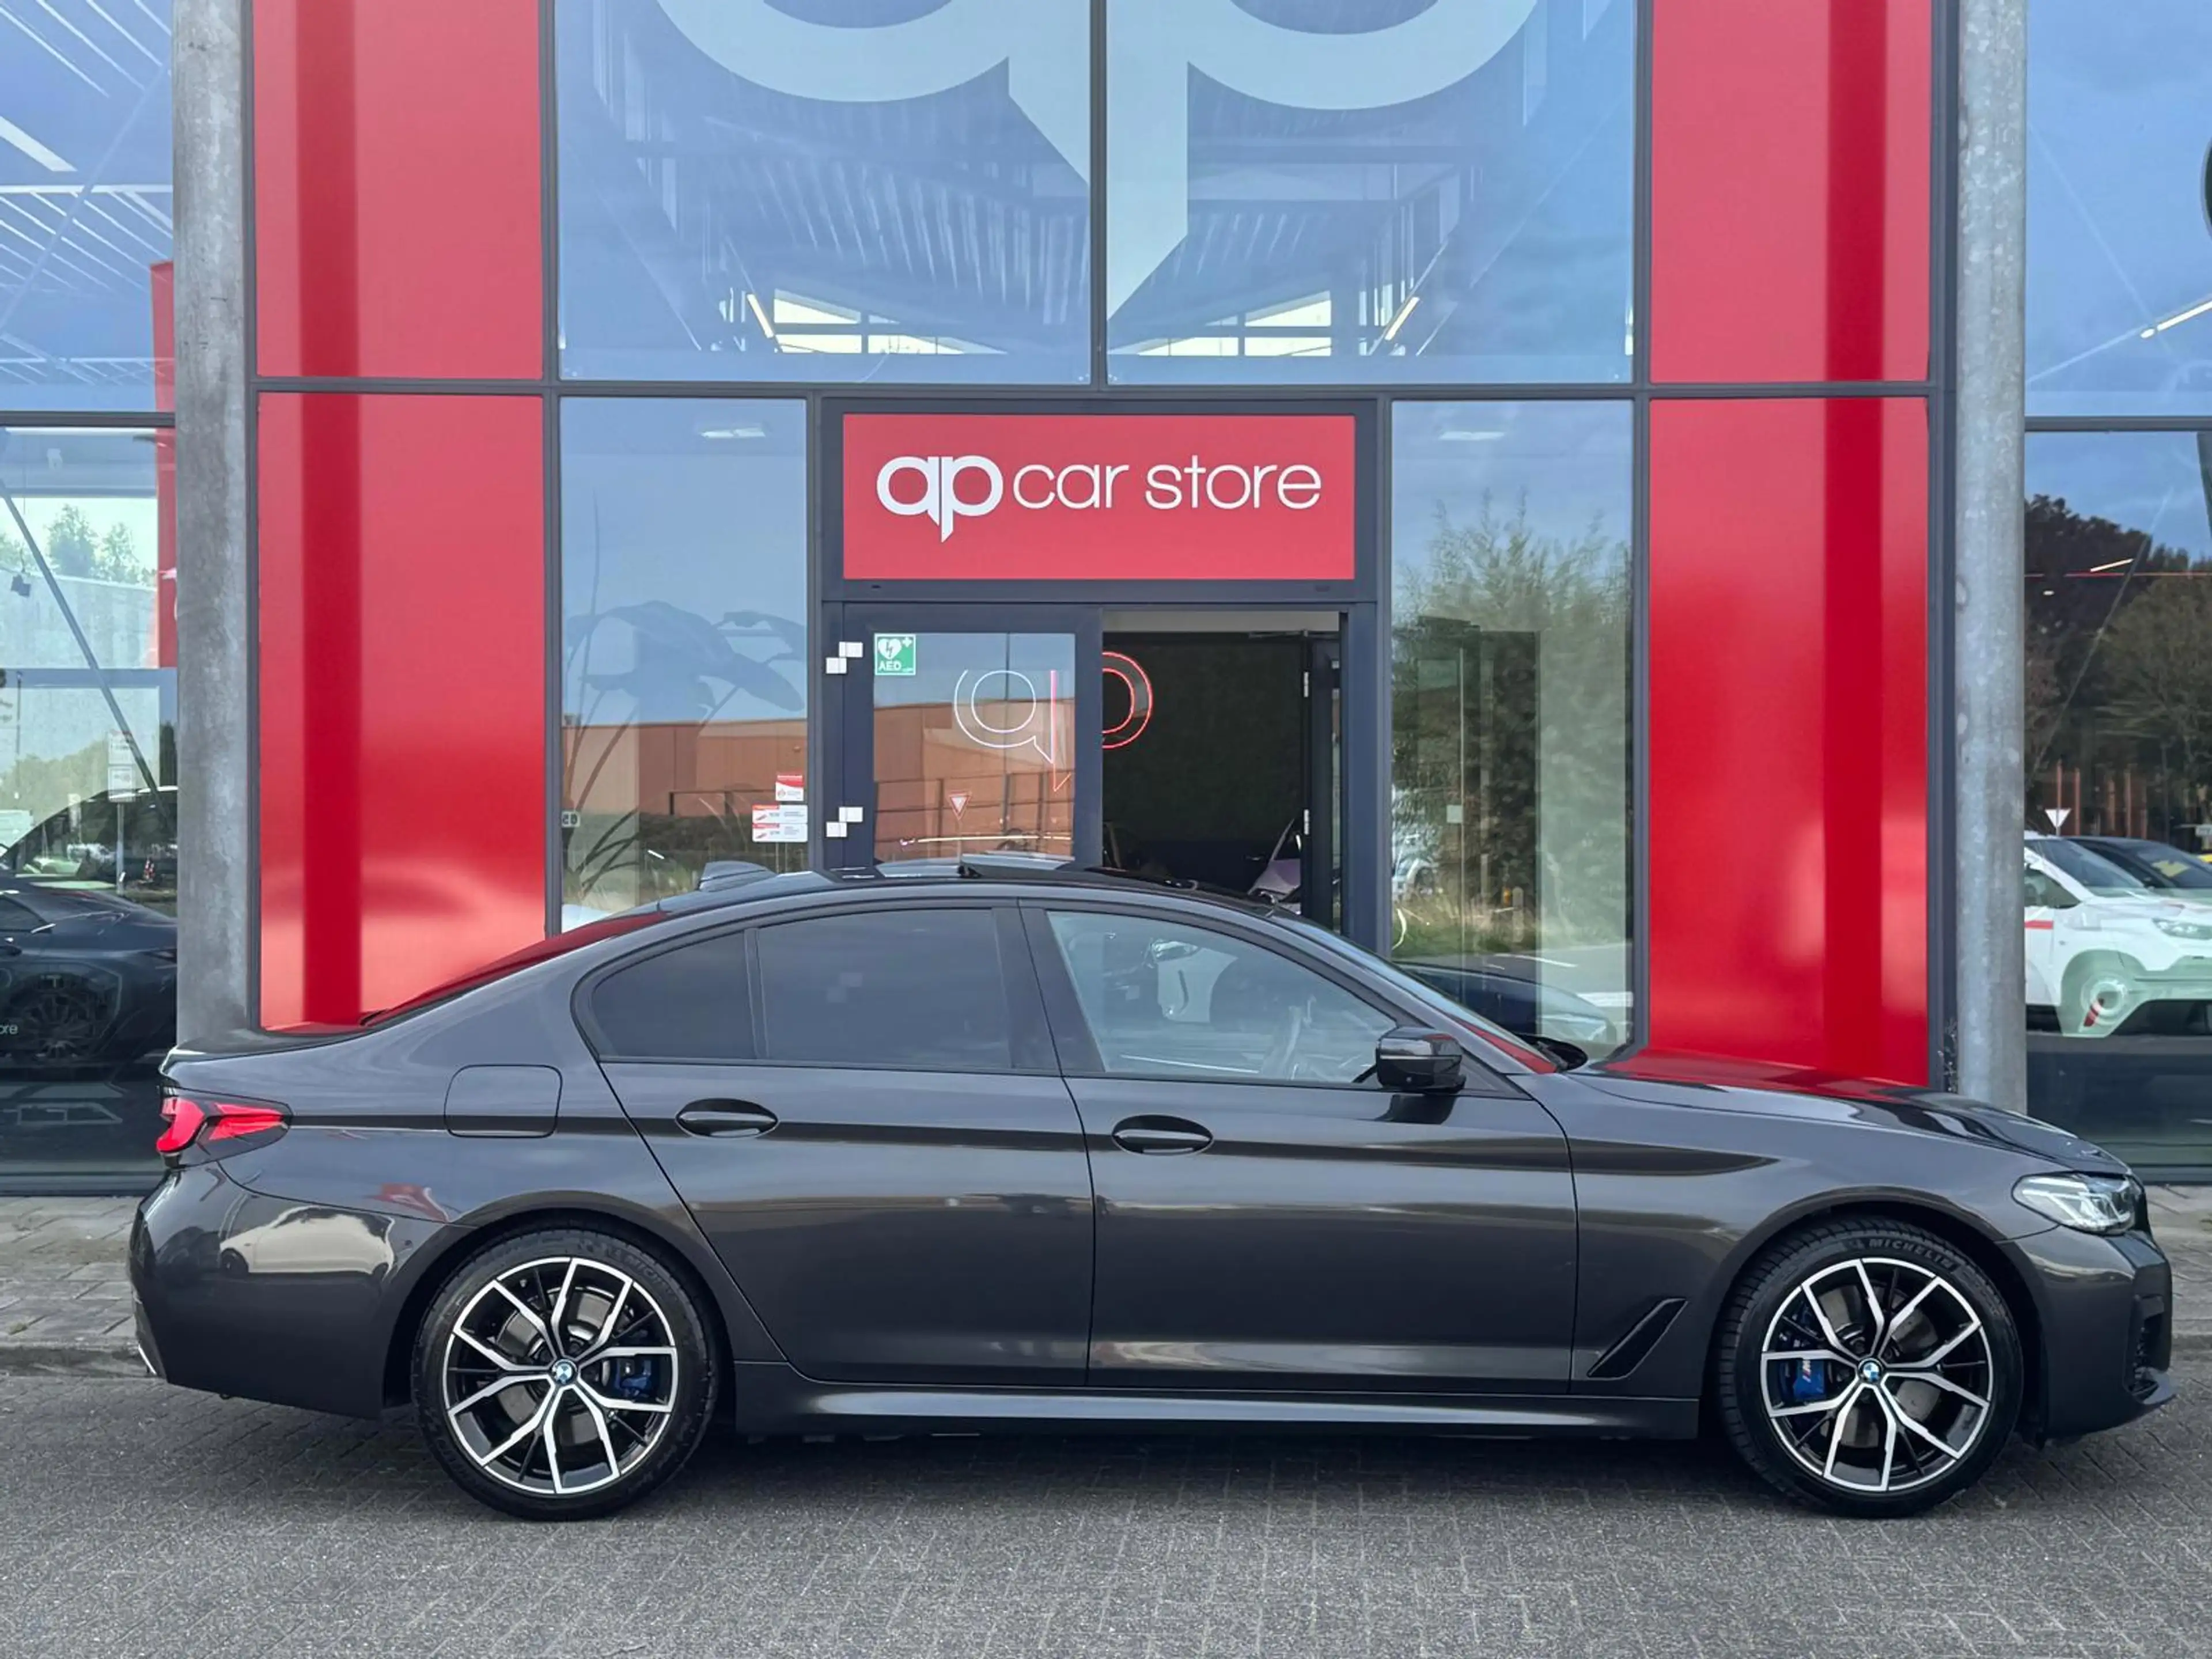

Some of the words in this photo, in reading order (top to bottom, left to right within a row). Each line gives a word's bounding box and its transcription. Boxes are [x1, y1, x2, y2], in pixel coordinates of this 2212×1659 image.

[877, 455, 1003, 543] ap
[1013, 464, 1129, 509] car
[1145, 454, 1321, 509] store
[878, 660, 902, 671] AED
